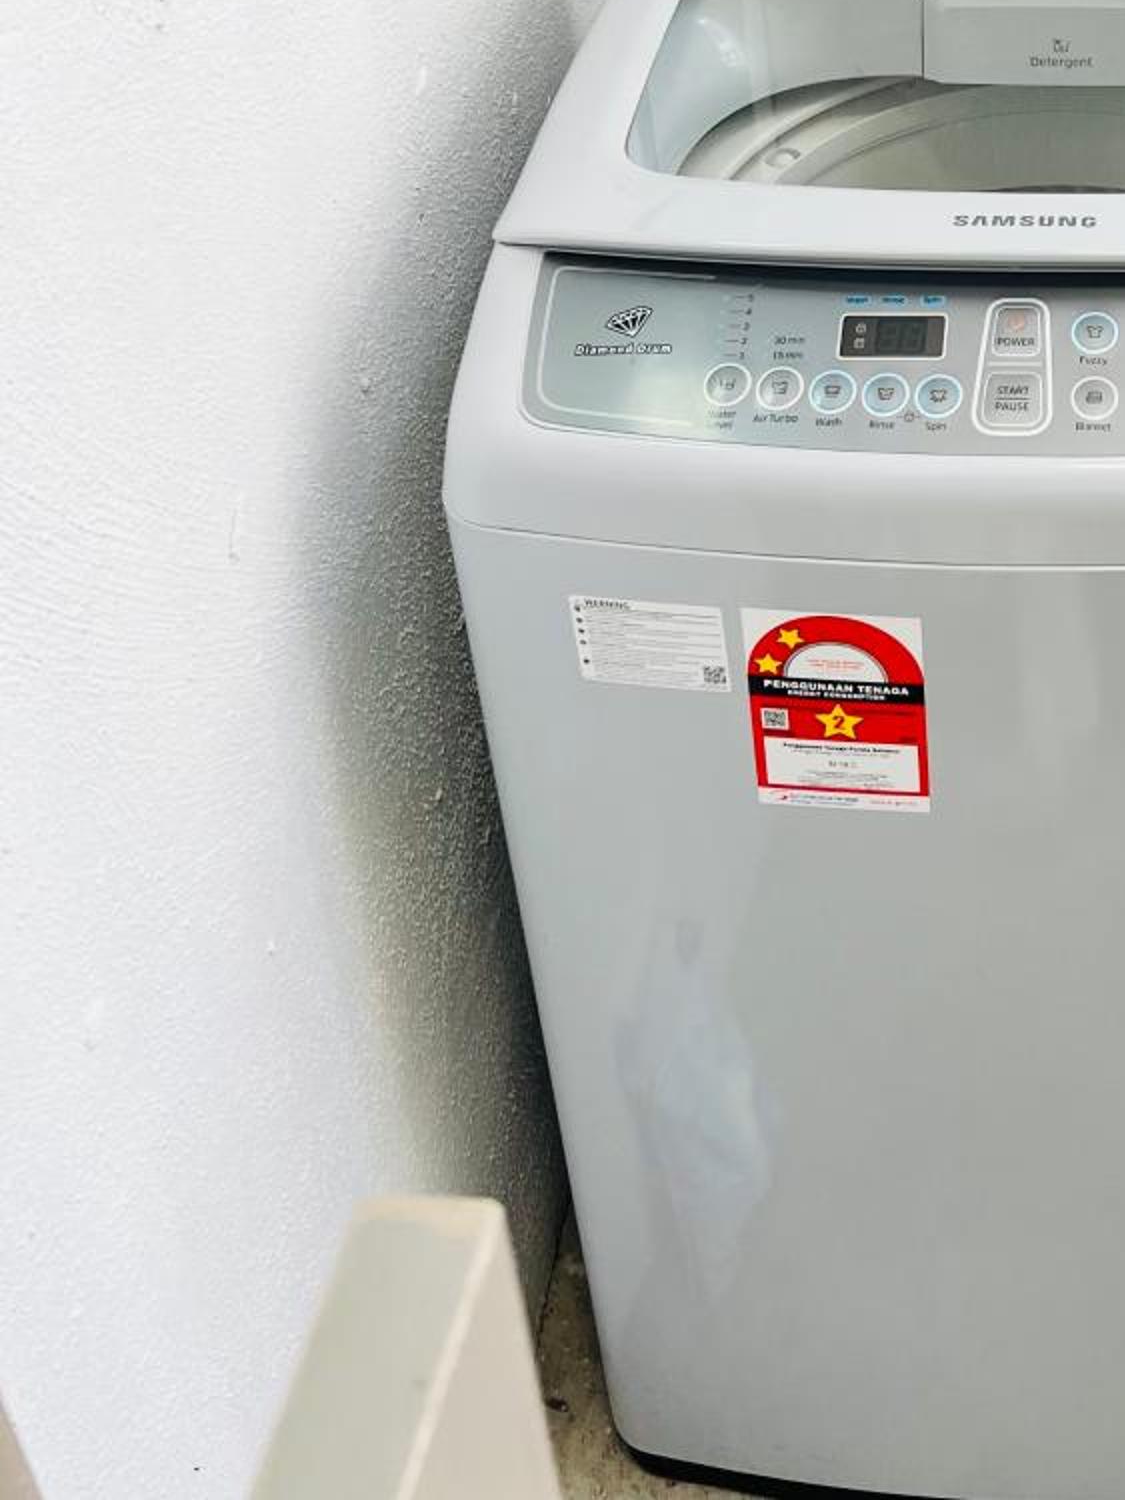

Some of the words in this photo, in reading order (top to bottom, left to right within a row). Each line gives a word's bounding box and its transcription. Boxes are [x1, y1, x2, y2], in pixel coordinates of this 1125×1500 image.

[1029, 56, 1092, 69] Detergent
[953, 214, 1098, 229] SAMSUNG
[996, 337, 1035, 347] POWER
[574, 342, 635, 357] Diamond
[996, 385, 1030, 395] START
[994, 401, 1030, 411] PAUSE
[763, 679, 854, 693] PENGGUNAAN
[857, 684, 910, 697] TENAGA
[832, 714, 846, 731] 2
